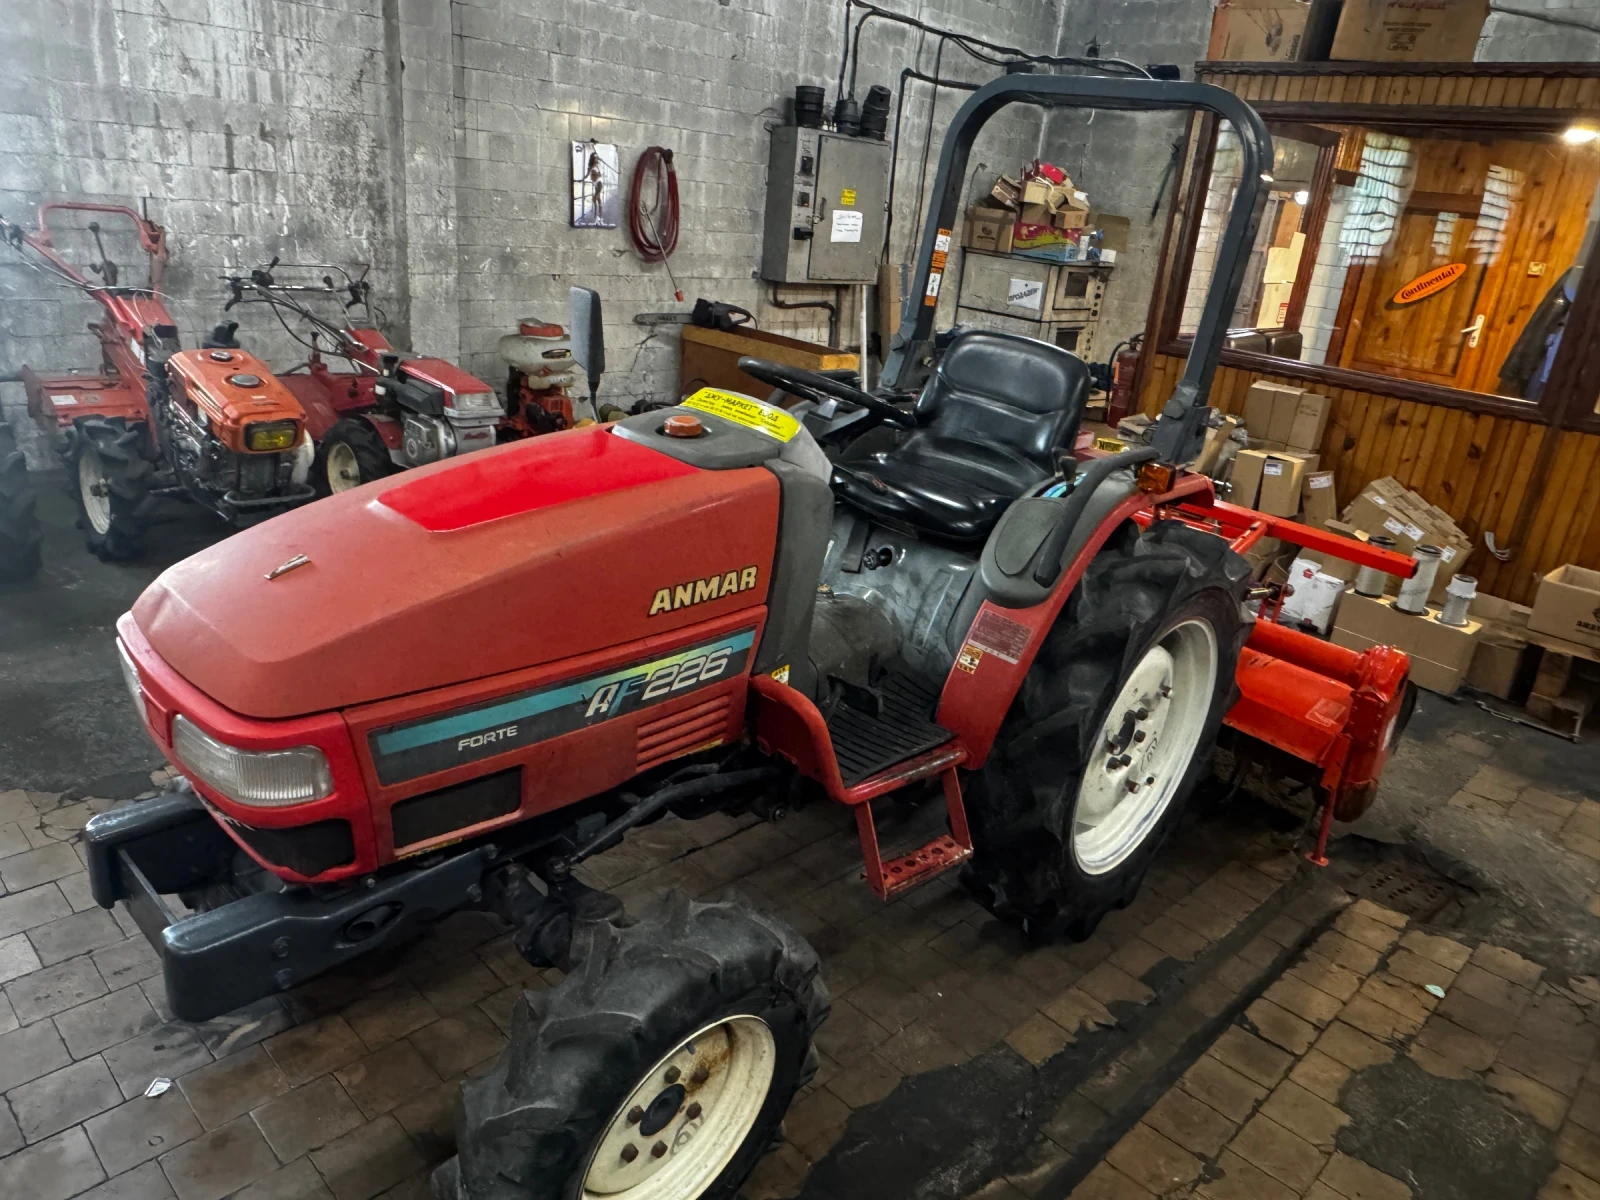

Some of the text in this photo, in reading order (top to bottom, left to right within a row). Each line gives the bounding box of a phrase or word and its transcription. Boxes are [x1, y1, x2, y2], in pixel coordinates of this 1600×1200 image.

[1401, 266, 1456, 300] Continental
[647, 565, 758, 617] ANMAR
[457, 725, 518, 751] FORTE
